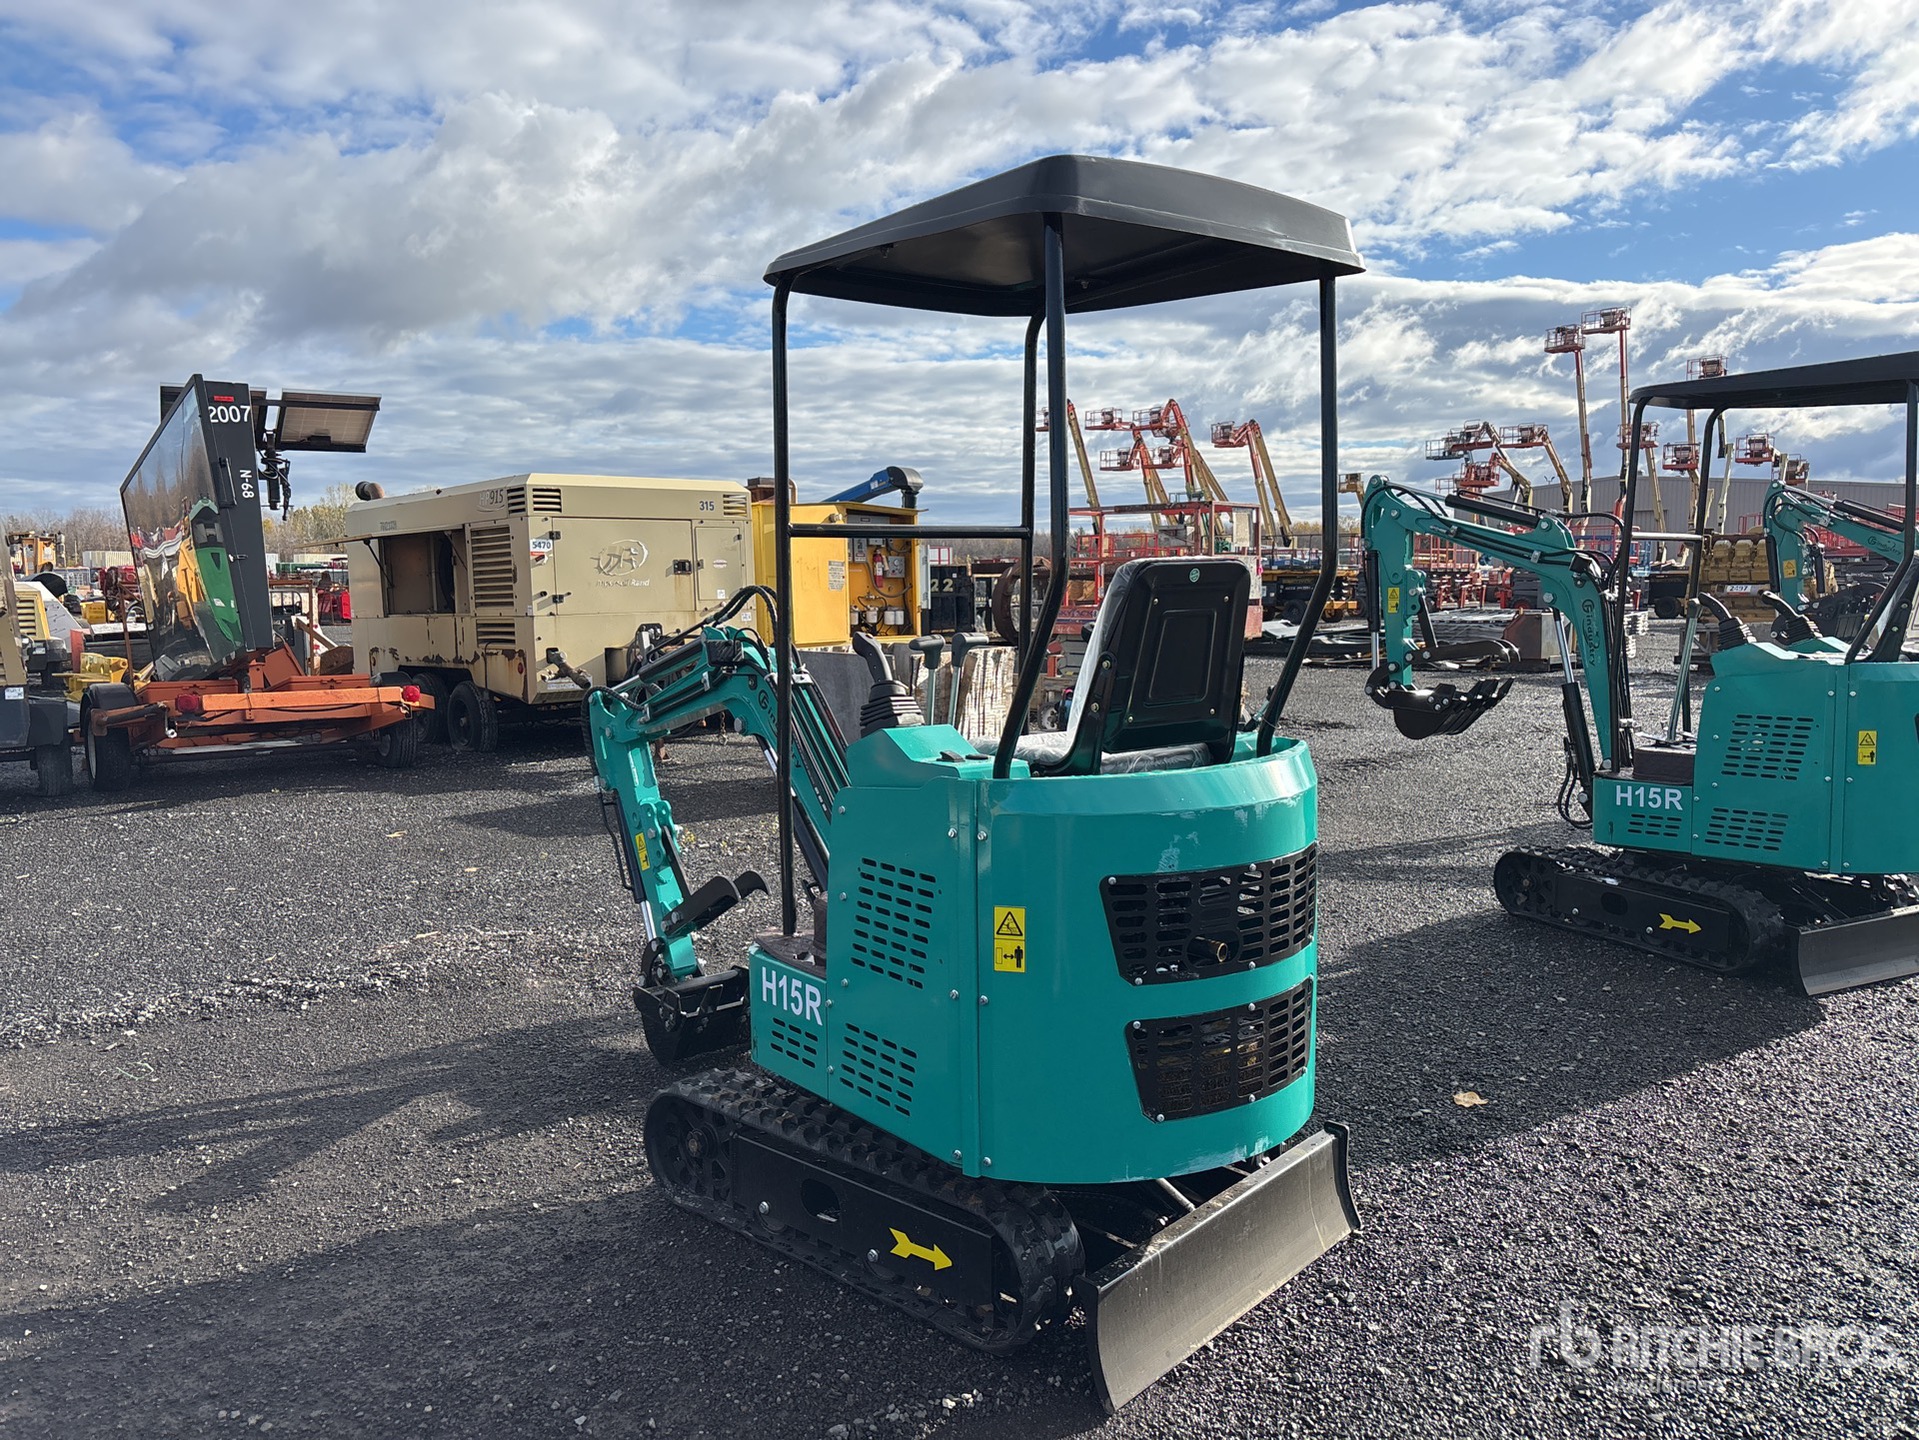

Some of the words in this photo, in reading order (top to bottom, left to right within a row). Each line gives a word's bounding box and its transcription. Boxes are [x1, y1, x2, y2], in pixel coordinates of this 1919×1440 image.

[208, 405, 251, 423] 2007
[239, 469, 254, 499] N-68
[699, 501, 714, 511] 315
[532, 541, 551, 549] 5470
[1616, 785, 1683, 811] H15R
[762, 966, 823, 1026] H15R
